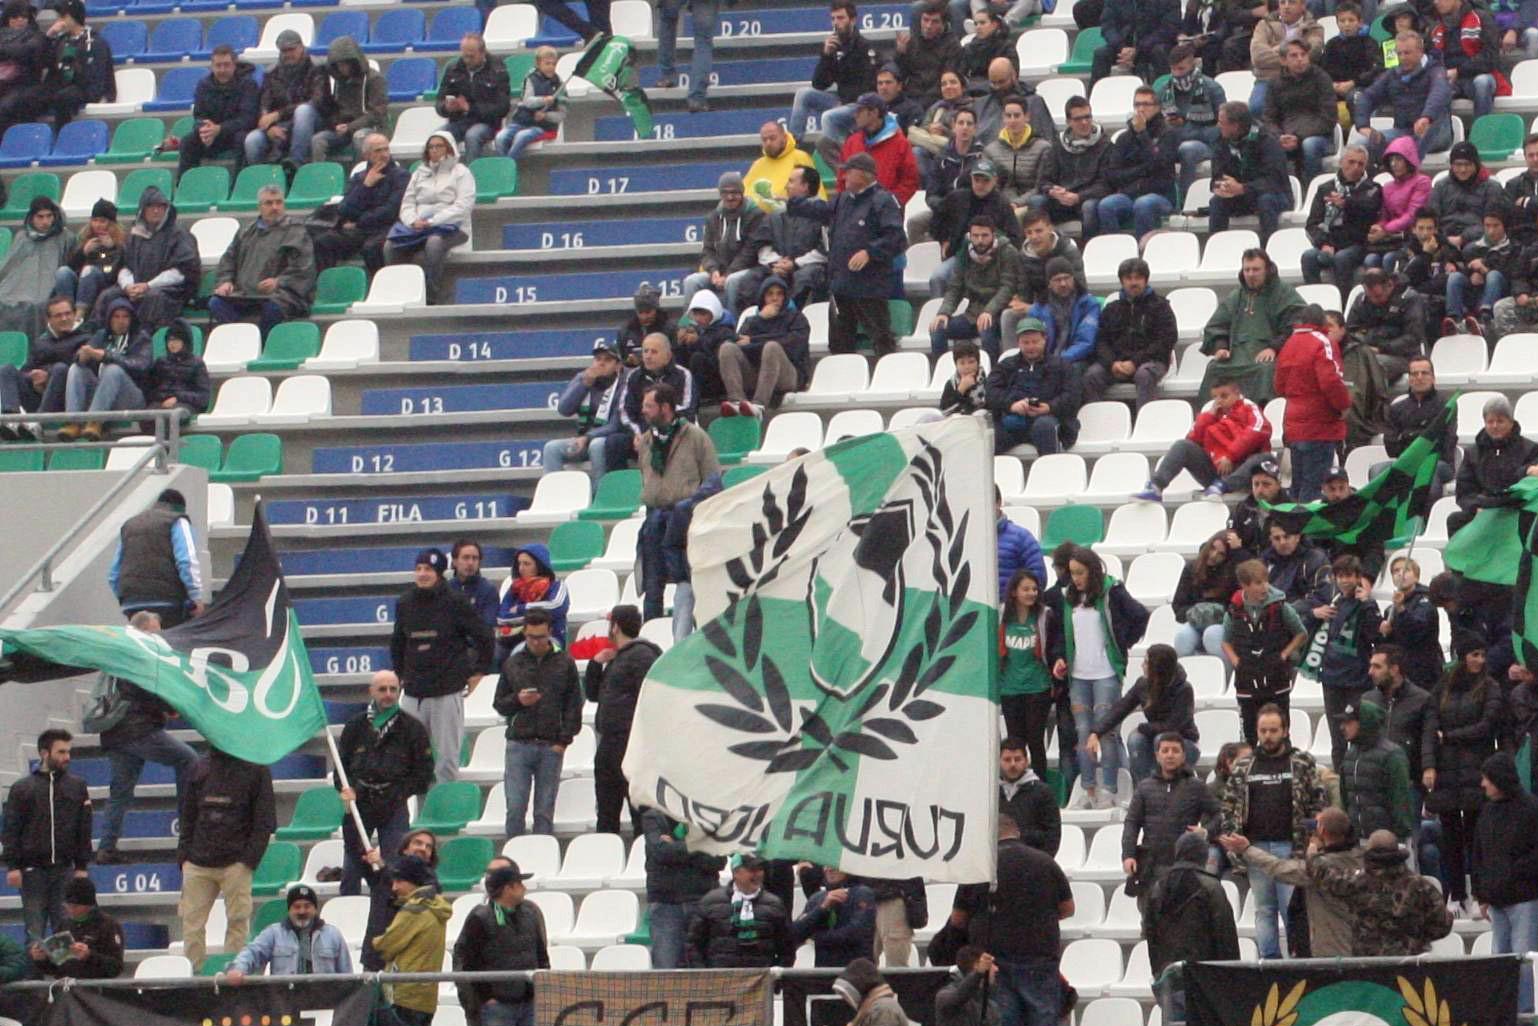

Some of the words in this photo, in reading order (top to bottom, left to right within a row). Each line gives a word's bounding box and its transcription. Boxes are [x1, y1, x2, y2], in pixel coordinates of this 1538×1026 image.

[722, 22, 733, 36] D
[740, 21, 761, 36] 20
[862, 15, 874, 30] G
[881, 13, 903, 29] 20
[679, 74, 689, 89] D
[653, 123, 676, 140] 18
[588, 178, 600, 194] D
[607, 177, 630, 193] 17
[541, 233, 553, 249] D
[561, 232, 583, 248] 16
[685, 225, 698, 241] G
[495, 287, 508, 303] D
[515, 286, 537, 302] 15
[658, 280, 681, 297] 15
[449, 344, 461, 360] D
[469, 342, 491, 359] 14
[401, 398, 413, 414] D
[421, 397, 443, 413] 13
[548, 393, 560, 409] G
[352, 456, 364, 473] D
[372, 455, 394, 472] 12
[499, 451, 511, 467] G
[518, 450, 541, 467] 12
[306, 507, 318, 524] D
[325, 506, 348, 523] 11
[377, 504, 422, 523] FILA
[455, 503, 467, 519] G
[474, 501, 498, 519] 11
[376, 604, 388, 622] G
[327, 656, 340, 673] G
[346, 655, 371, 672] 08
[115, 873, 128, 891] G
[135, 872, 160, 891] 04
